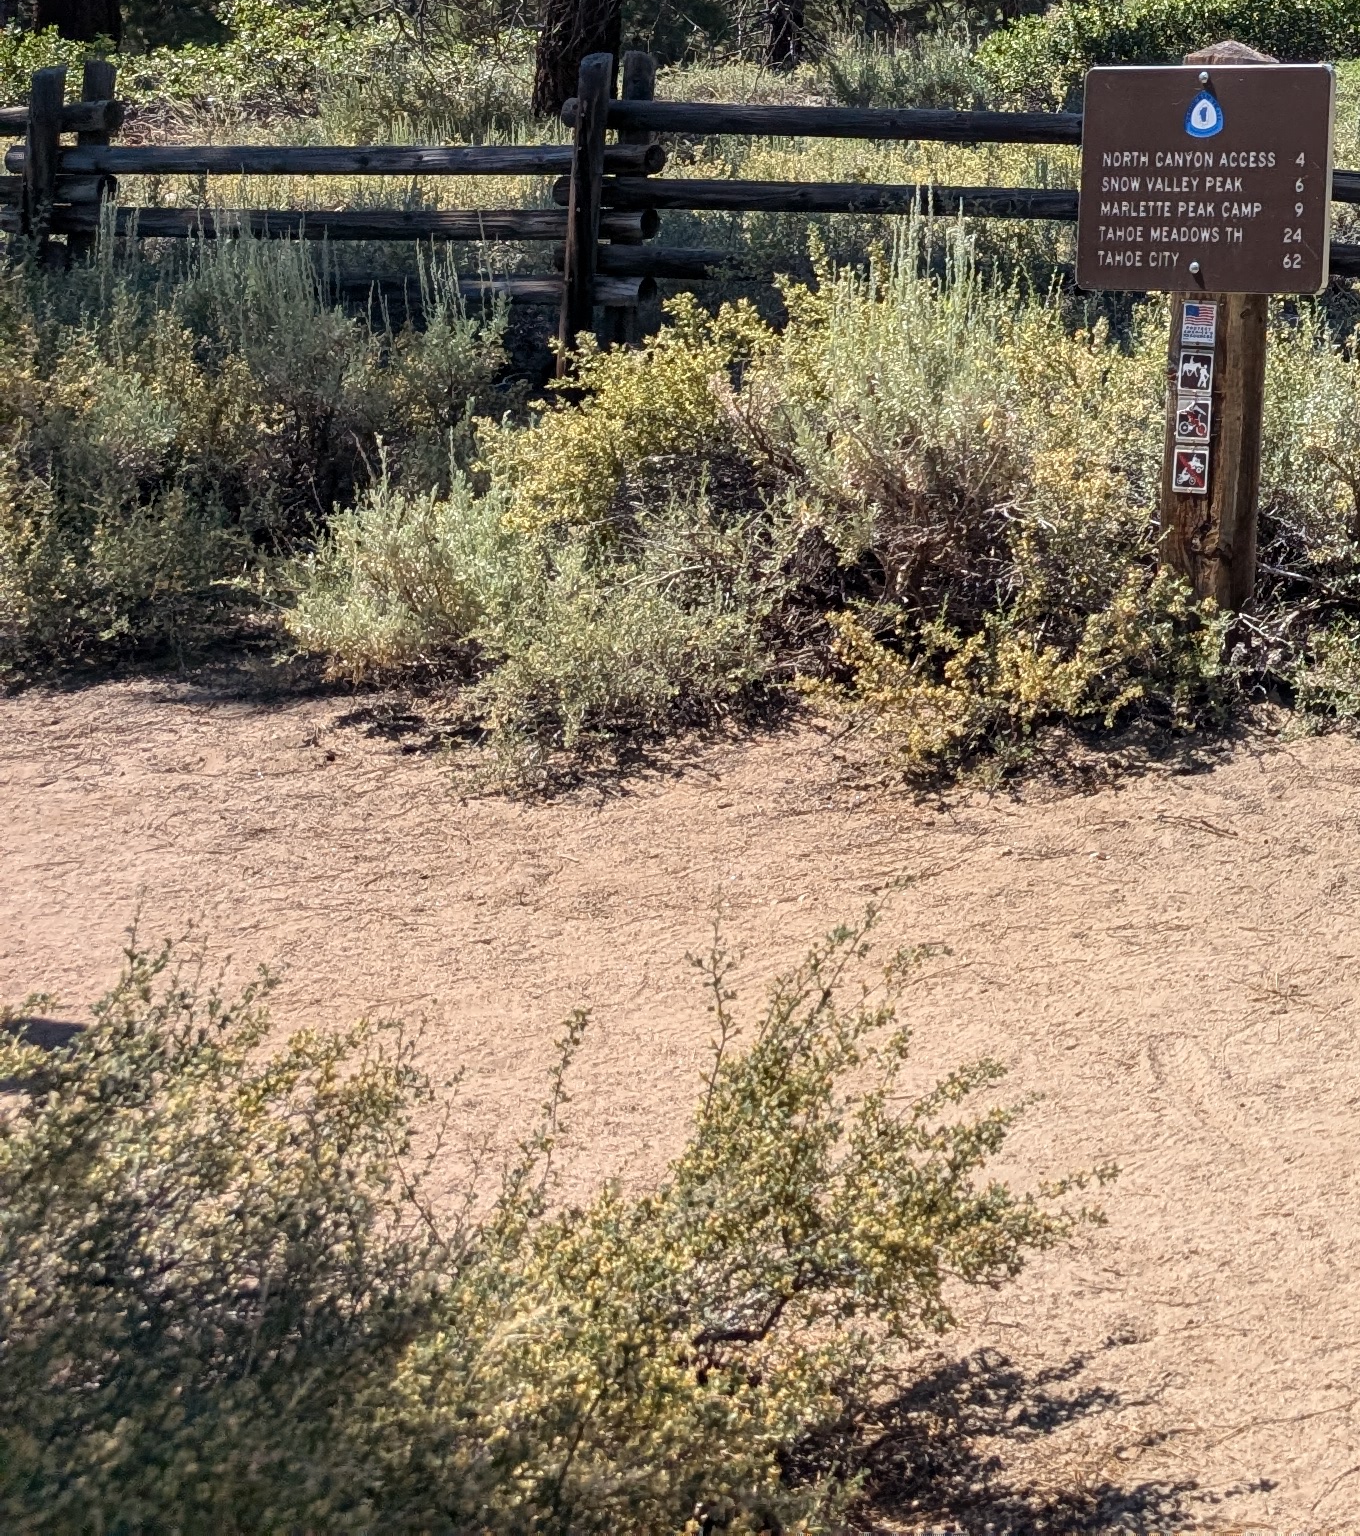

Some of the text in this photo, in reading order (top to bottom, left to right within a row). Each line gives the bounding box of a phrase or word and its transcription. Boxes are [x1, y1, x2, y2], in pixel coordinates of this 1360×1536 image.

[1102, 151, 1305, 167] NORTH CANYON ACCESS 4
[1101, 176, 1304, 193] SNOW VALLEY PEAK 6
[1100, 201, 1304, 217] MARLETTE PEAK CAMP 9
[1098, 226, 1302, 243] TAHOE MEADOWS TH 24
[1097, 250, 1302, 269] TAHOE CITY 62
